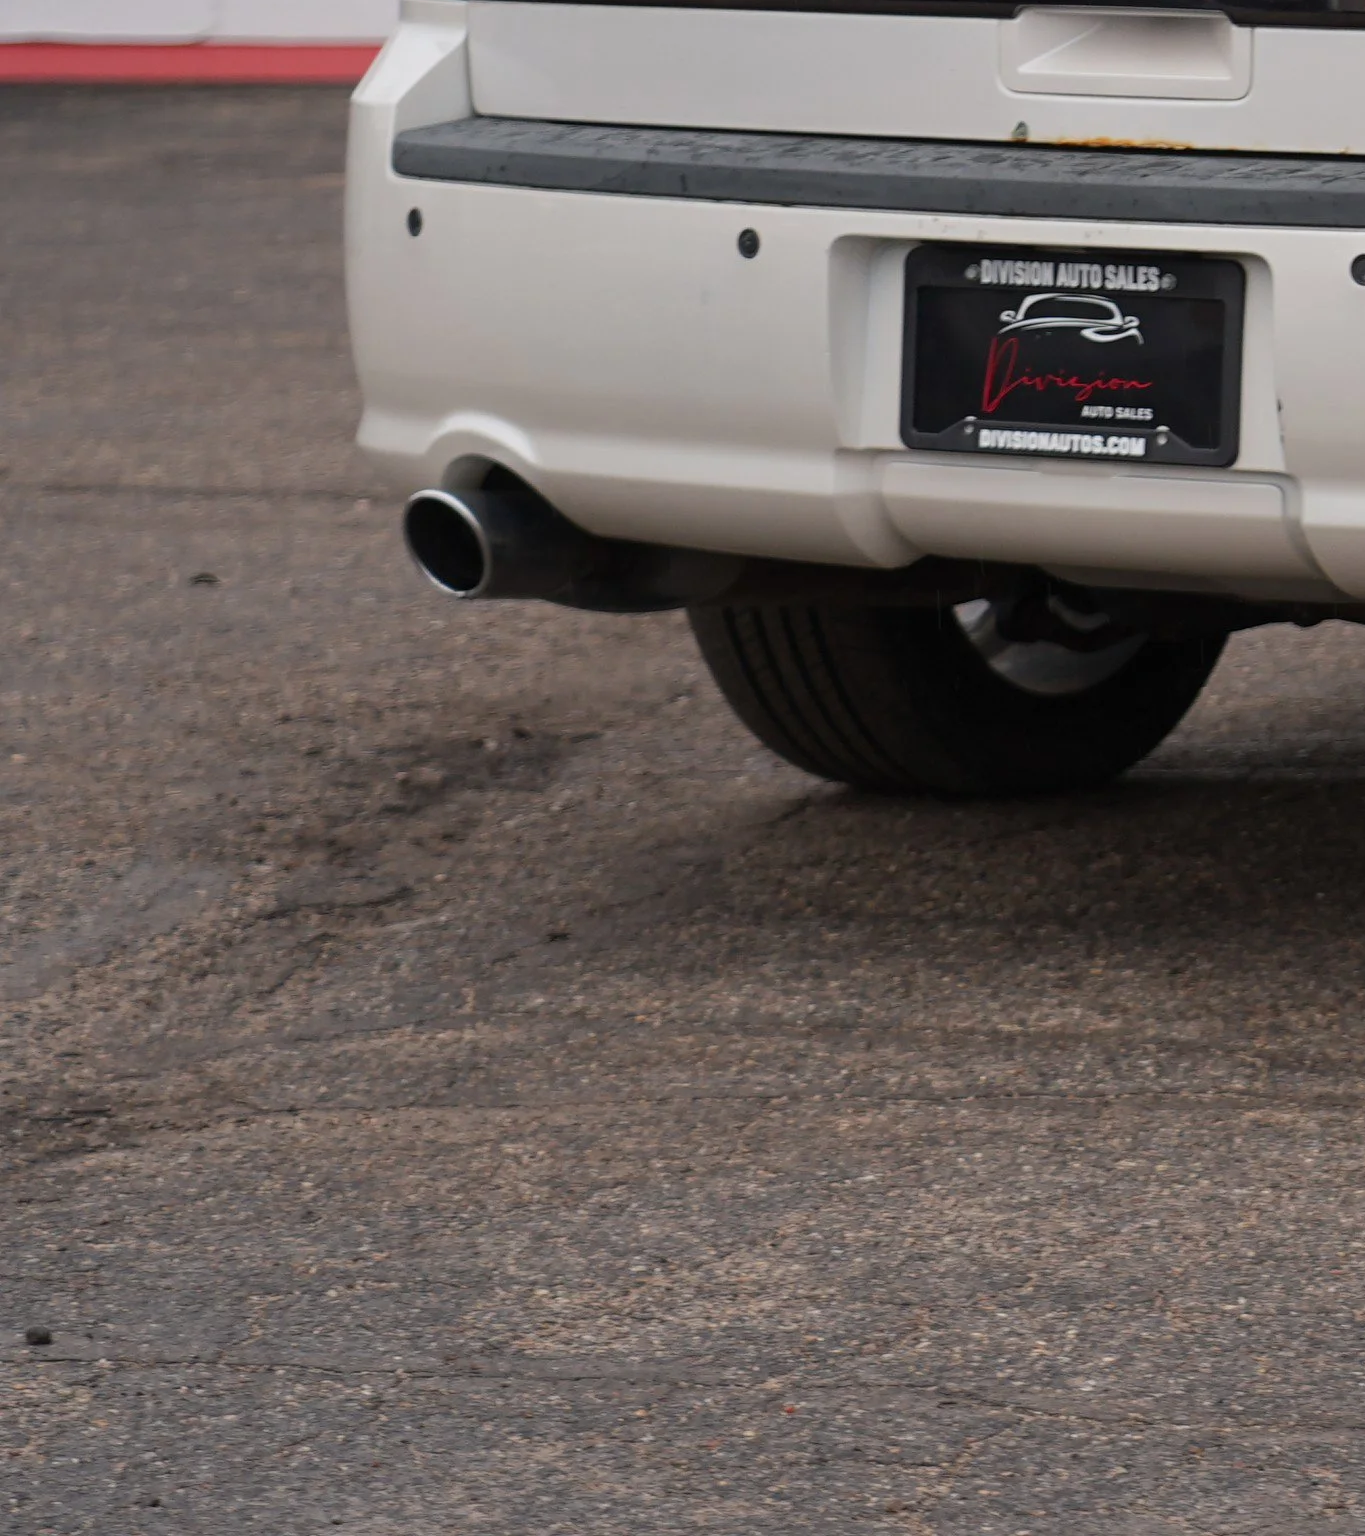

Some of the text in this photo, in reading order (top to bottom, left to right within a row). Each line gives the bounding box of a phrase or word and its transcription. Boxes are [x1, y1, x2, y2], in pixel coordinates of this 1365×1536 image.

[980, 259, 1161, 292] DIVISION AUTO SALES
[981, 337, 1153, 412] Division
[1081, 405, 1153, 421] AUTO SALES
[979, 429, 1146, 456] DIVISIONAUTOS.COM
